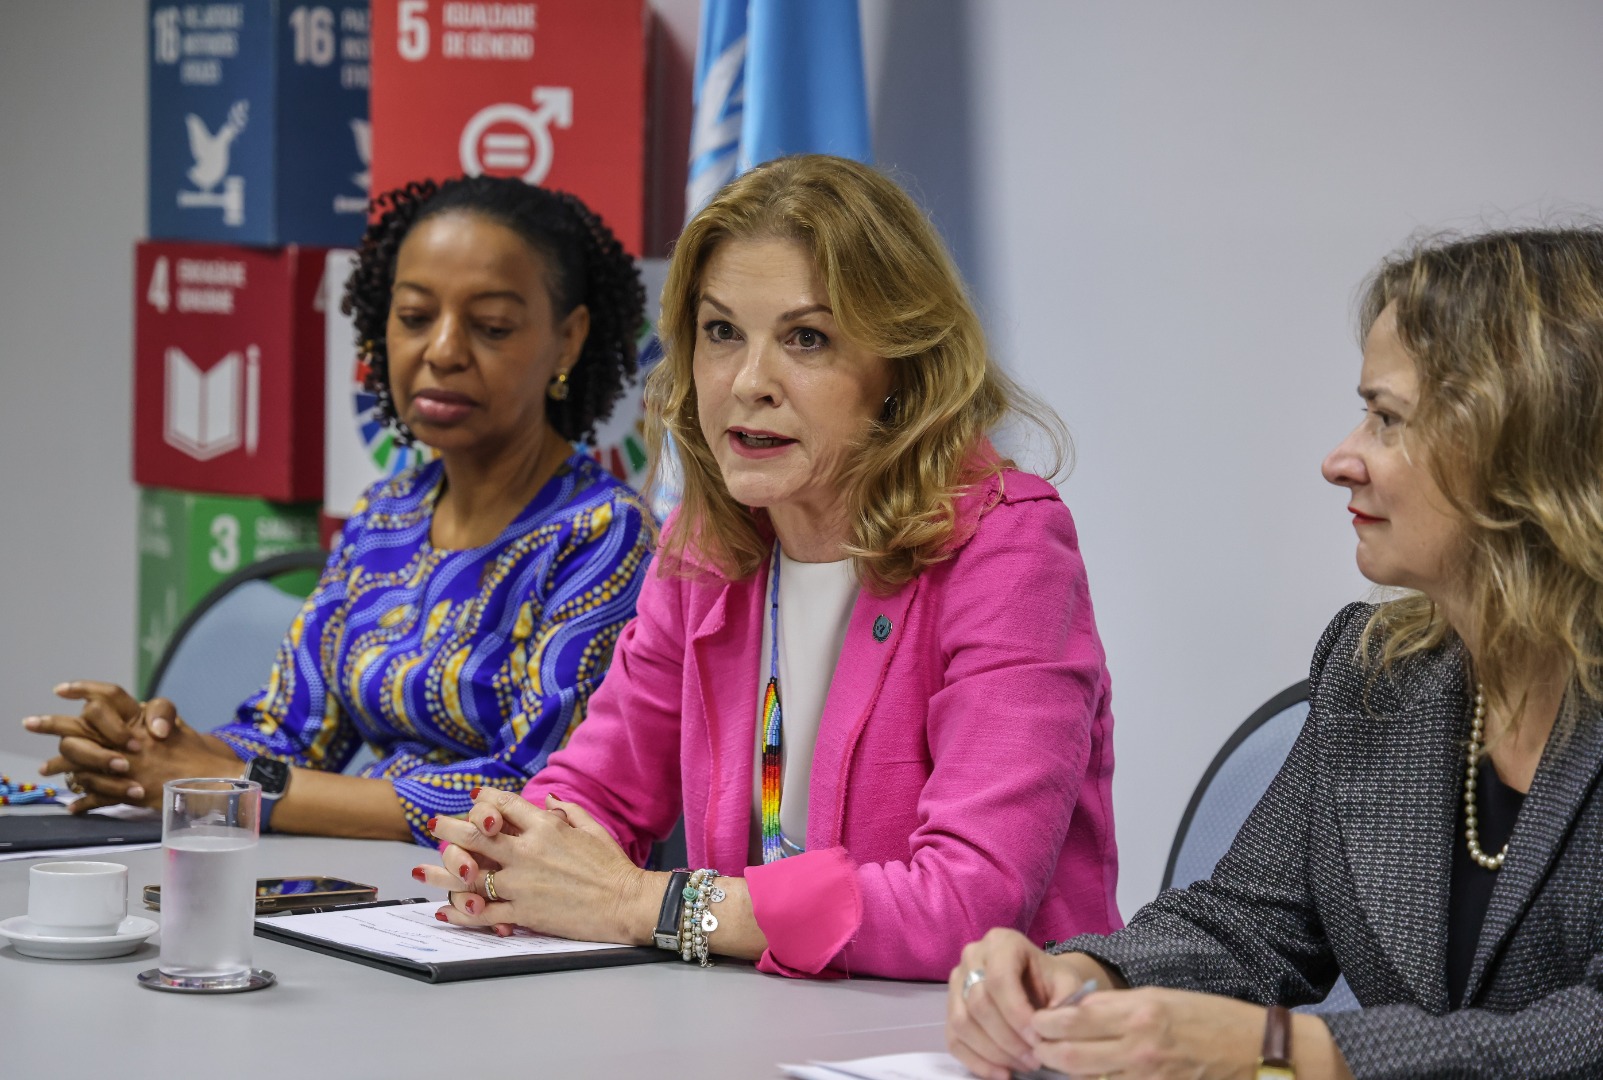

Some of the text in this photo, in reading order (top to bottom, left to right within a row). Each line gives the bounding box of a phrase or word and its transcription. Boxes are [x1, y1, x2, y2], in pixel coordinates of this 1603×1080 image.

[289, 6, 335, 66] 16
[397, 0, 430, 61] 5
[442, 31, 535, 60] DE GÊNERO
[443, 3, 537, 30] IGUALDADE
[148, 256, 170, 314] 4
[209, 513, 240, 573] 3
